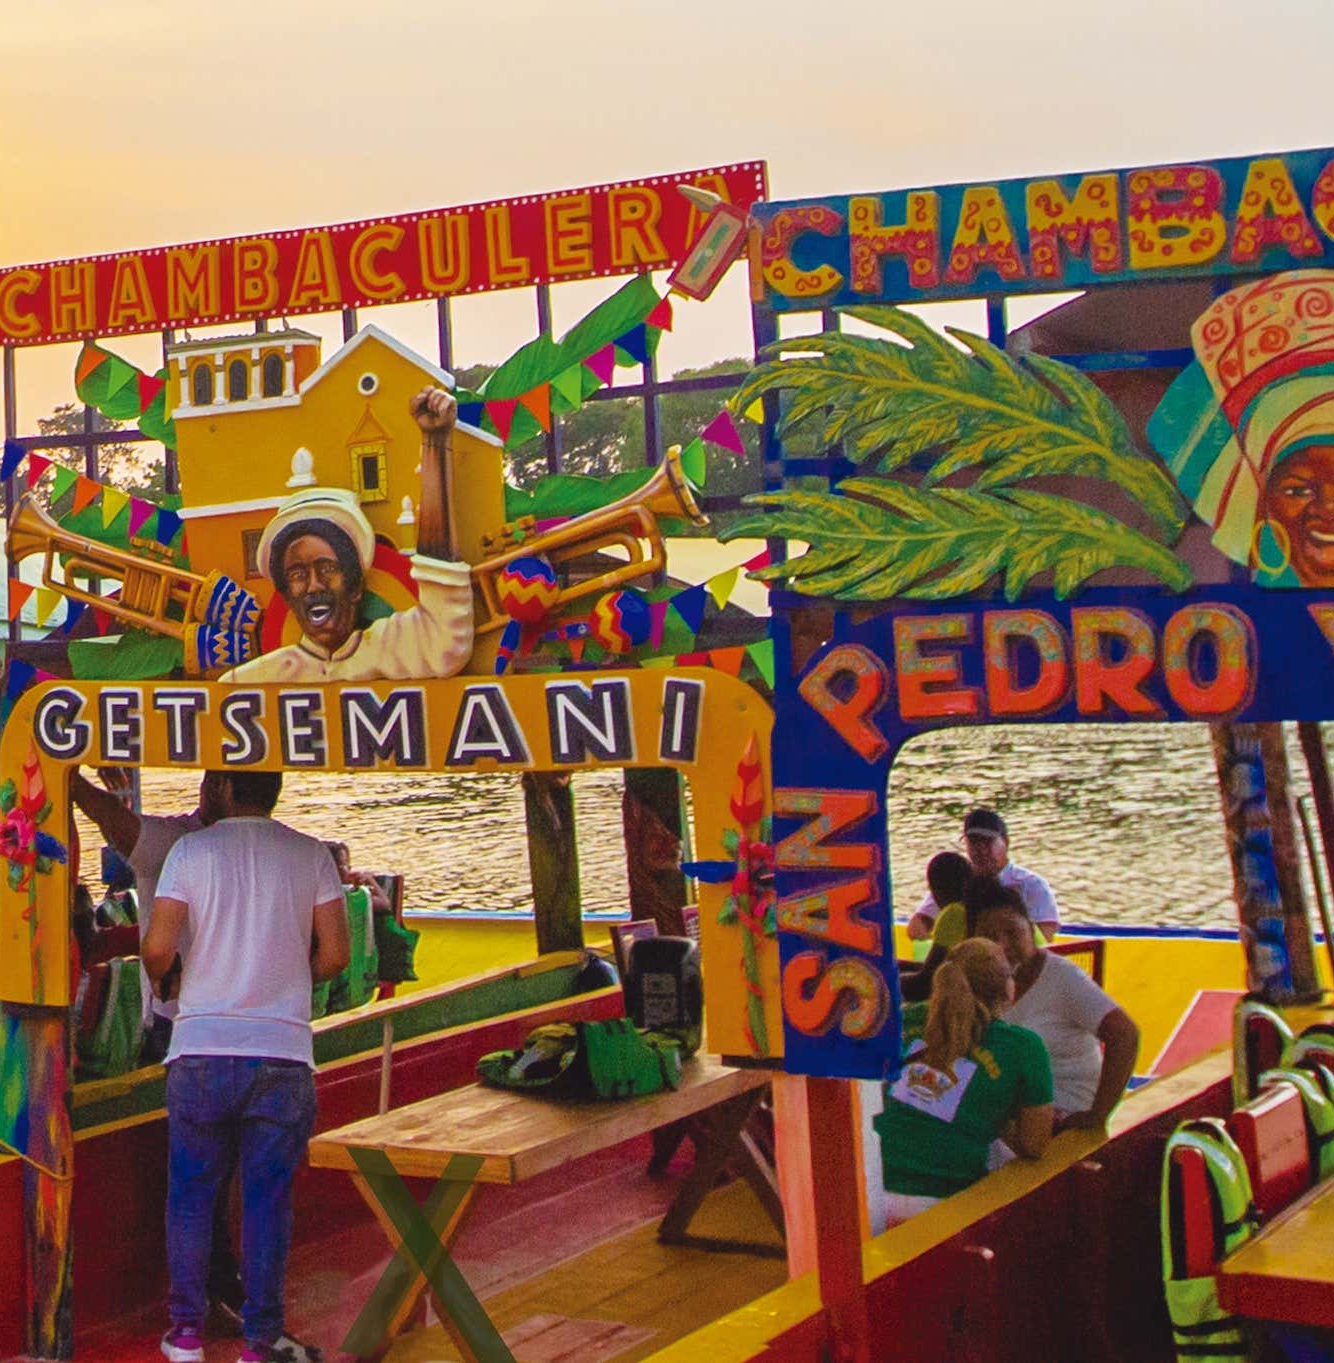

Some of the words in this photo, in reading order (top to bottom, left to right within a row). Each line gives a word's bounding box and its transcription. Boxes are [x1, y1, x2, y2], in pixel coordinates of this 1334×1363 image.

[33, 680, 704, 768] GETSEMANI
[797, 602, 1259, 764] PEDRO
[773, 787, 891, 1038] SAN
